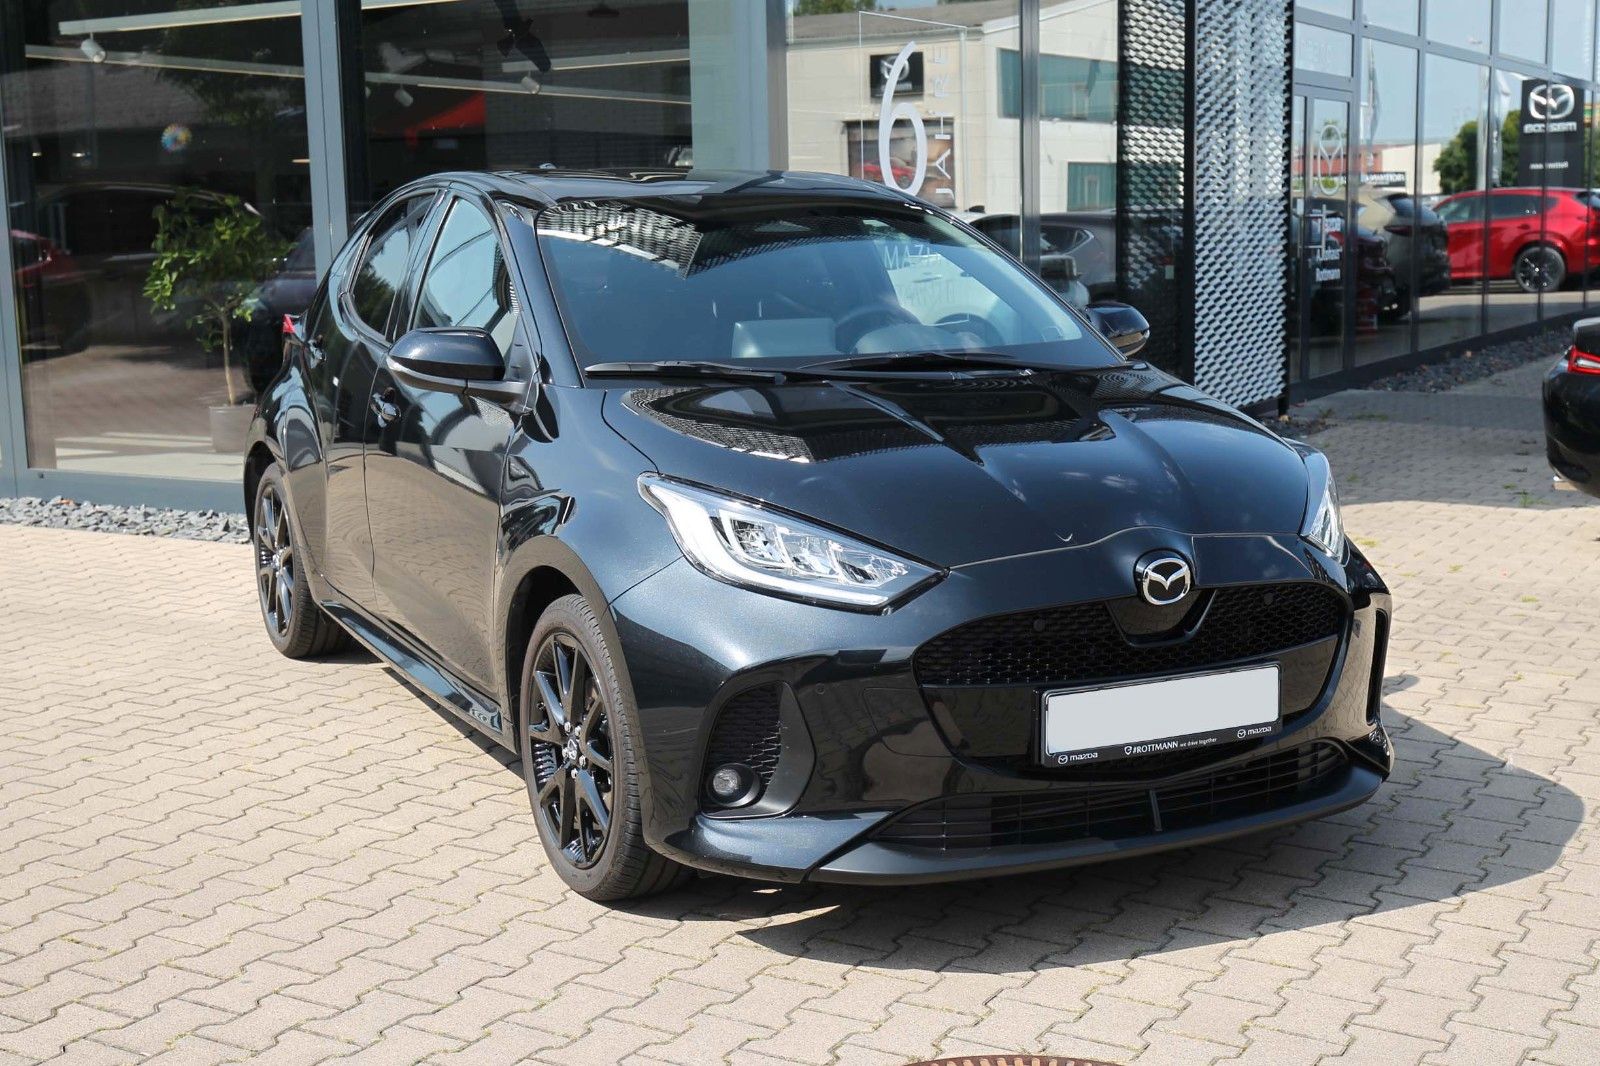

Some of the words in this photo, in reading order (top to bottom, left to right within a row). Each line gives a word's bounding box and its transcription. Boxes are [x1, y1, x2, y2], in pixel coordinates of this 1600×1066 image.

[878, 41, 928, 197] 6
[1247, 726, 1272, 735] mazda
[1070, 752, 1098, 761] mazda
